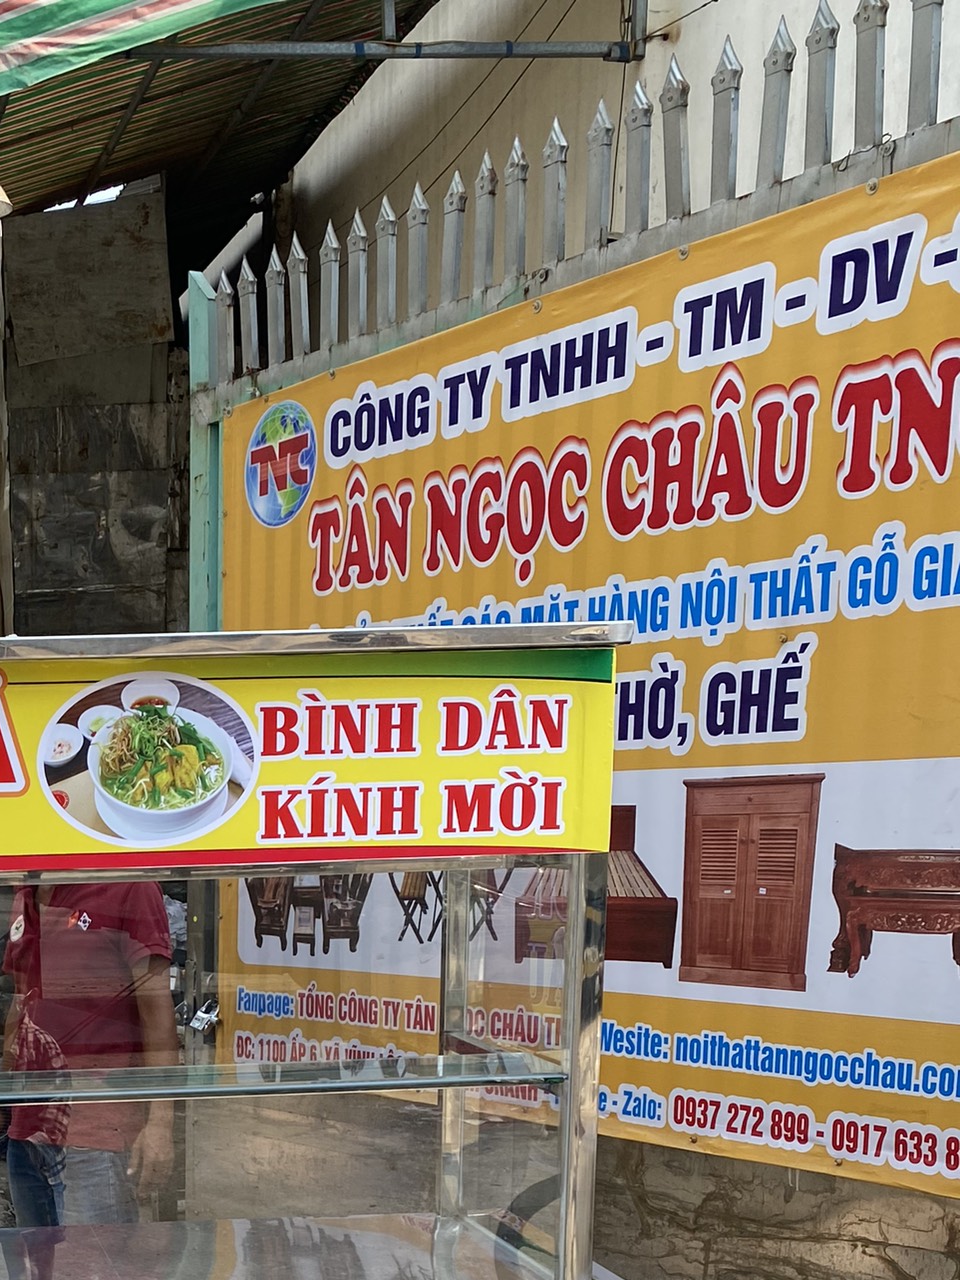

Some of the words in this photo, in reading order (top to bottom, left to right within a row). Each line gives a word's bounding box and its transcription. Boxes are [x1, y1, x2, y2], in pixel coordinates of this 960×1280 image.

[329, 385, 431, 458] CÔNG
[443, 364, 492, 426] TY
[504, 321, 629, 410] TNHH
[683, 277, 766, 358] TM
[827, 230, 915, 319] DV
[311, 477, 413, 592] TÂN
[424, 449, 588, 582] NGỌC
[605, 378, 815, 536] CHÂU
[679, 567, 738, 637] NỘI
[749, 545, 837, 621] THẤT
[847, 531, 899, 609] GỖ
[259, 693, 418, 757] BÌNH
[440, 688, 568, 752] DÂN
[615, 662, 688, 746] HỜ,
[705, 641, 811, 737] GHẾ
[260, 776, 420, 840] KÍNH
[442, 771, 563, 834] MỜI
[237, 986, 295, 1017] Fanpage:
[297, 981, 334, 1020] TỔNG
[338, 991, 378, 1026] CÔNG
[383, 999, 401, 1028] TY
[404, 995, 436, 1032] TÂN
[490, 1008, 539, 1044] CHÂU
[675, 1033, 960, 1098] noithattanngocchau.co
[258, 1037, 287, 1063] 1100
[621, 1089, 662, 1122] Zalo:
[672, 1093, 721, 1129] 0937
[725, 1102, 765, 1138] 272
[770, 1108, 810, 1145] 899
[831, 1117, 888, 1158] 0917
[893, 1128, 938, 1168] 633
